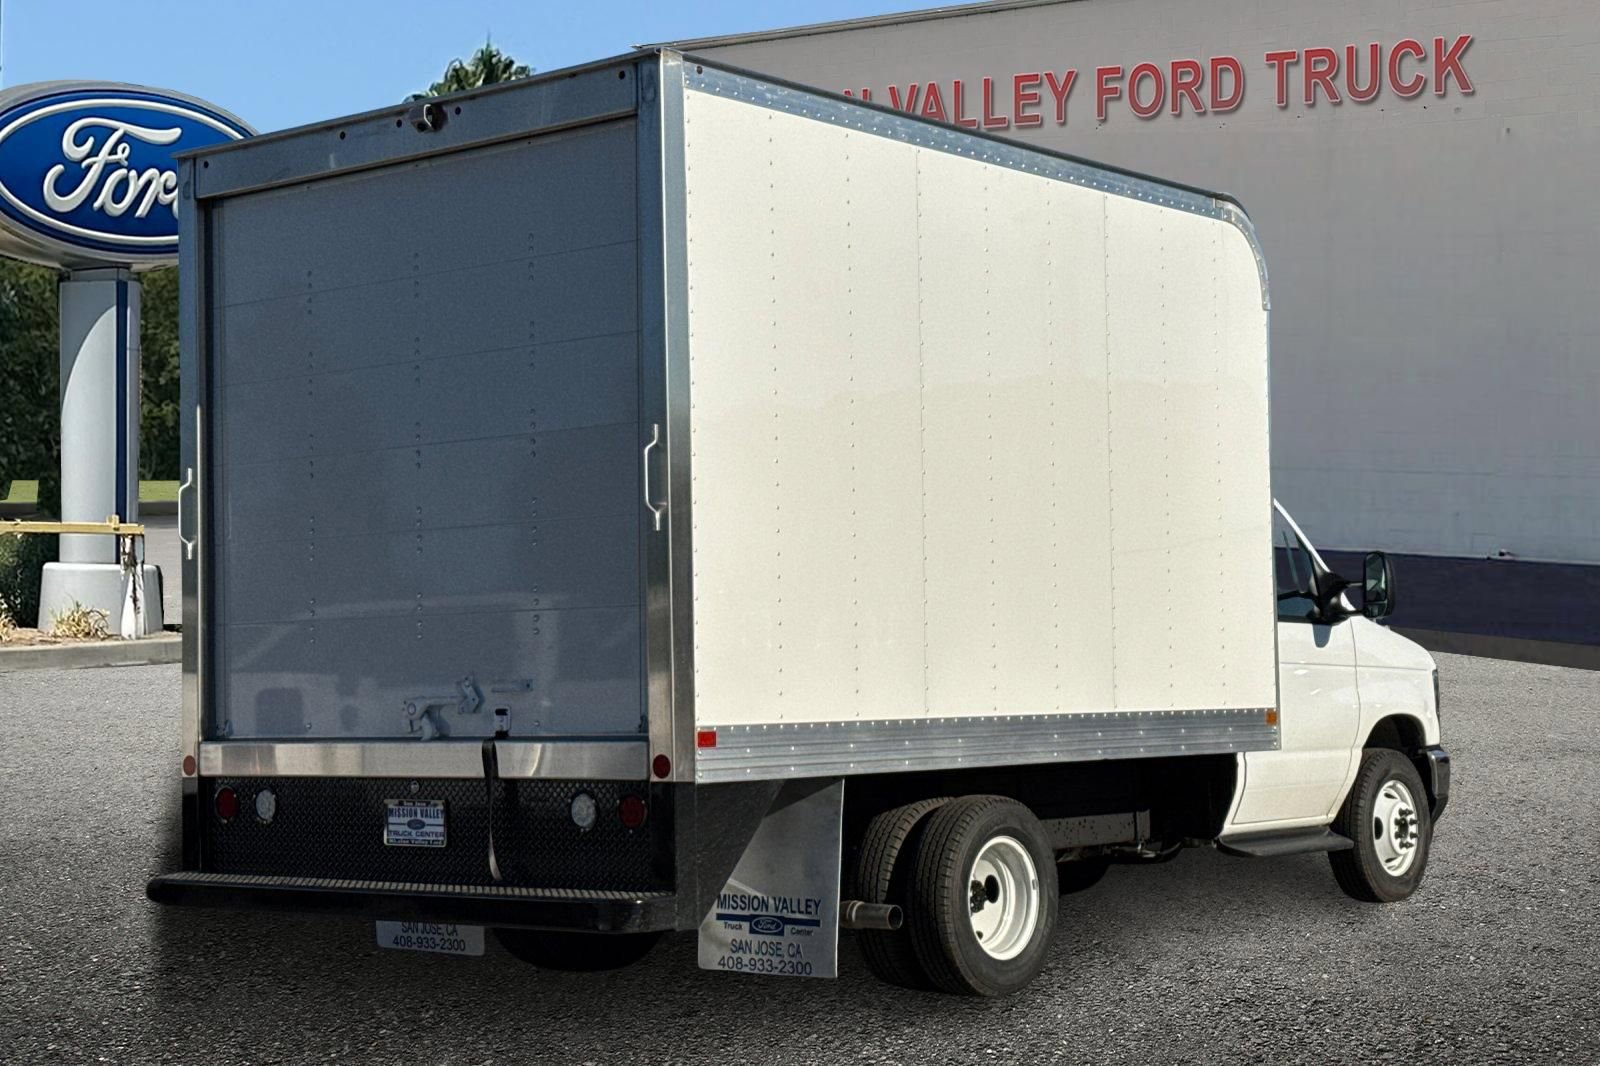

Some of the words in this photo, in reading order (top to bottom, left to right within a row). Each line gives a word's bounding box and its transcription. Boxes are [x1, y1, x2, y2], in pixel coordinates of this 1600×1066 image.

[1096, 55, 1243, 120] FORD
[1264, 34, 1474, 106] TRUCK
[43, 117, 178, 218] For
[388, 807, 418, 818] MISSION
[420, 807, 444, 819] VALLEY
[717, 893, 769, 913] MISSION
[773, 896, 821, 915] VALLEY
[723, 921, 742, 930] Truck
[756, 920, 777, 930] Ford
[790, 926, 814, 936] Center
[392, 935, 466, 952] 408-933-2300
[730, 938, 753, 955] SAN
[754, 940, 784, 958] JOSE,
[787, 942, 803, 958] CA
[718, 956, 812, 975] 408-933-2300
